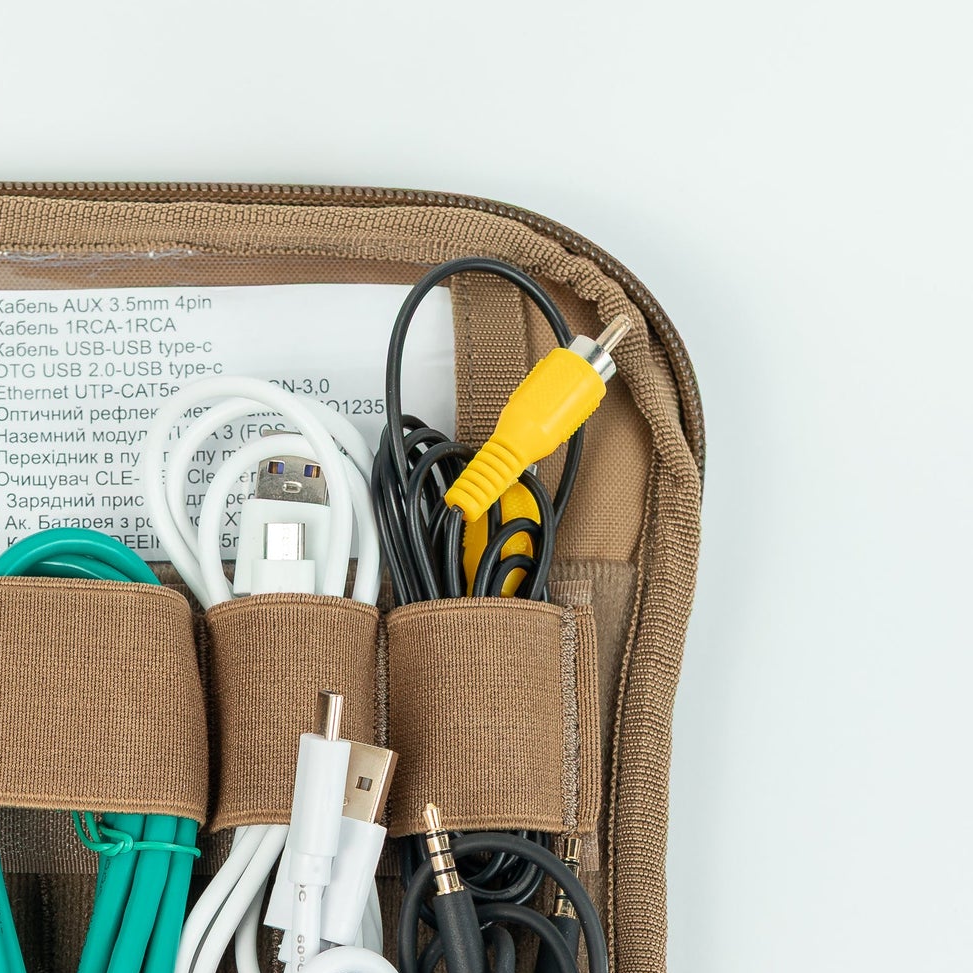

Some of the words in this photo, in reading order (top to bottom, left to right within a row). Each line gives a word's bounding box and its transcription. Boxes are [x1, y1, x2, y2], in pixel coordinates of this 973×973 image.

[63, 298, 102, 312] AUX
[110, 297, 168, 312] 3.5mm
[175, 295, 211, 312] 4pin
[67, 317, 176, 334] 1RCA-1RCA
[66, 340, 152, 356] USB-USB
[159, 340, 212, 357] type-c
[43, 363, 81, 377] USB
[89, 361, 162, 377] 2.0-USB
[169, 362, 222, 379] type-c
[92, 428, 148, 446] модул
[223, 425, 233, 439] 3
[104, 453, 113, 463] в
[7, 493, 95, 511] Зарядний
[5, 515, 31, 530] Ак.
[39, 515, 115, 530] Батарея
[120, 517, 129, 528] з
